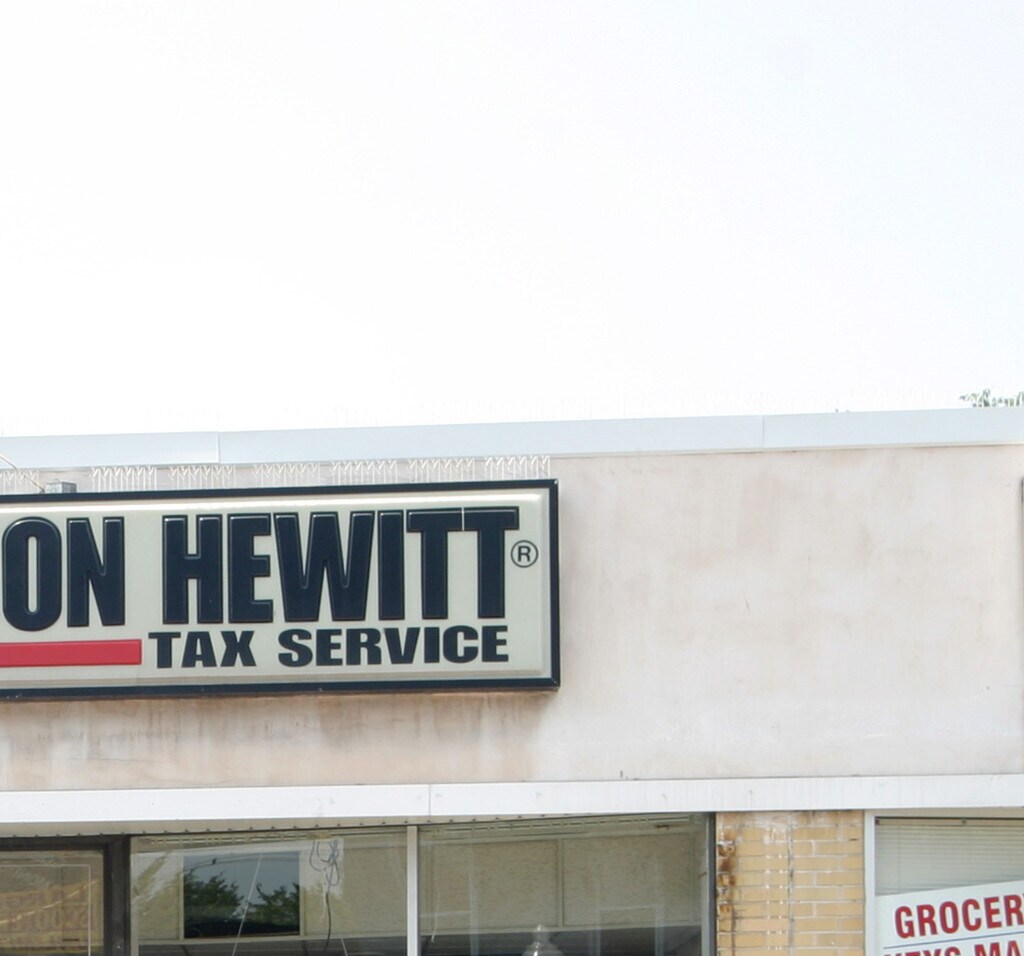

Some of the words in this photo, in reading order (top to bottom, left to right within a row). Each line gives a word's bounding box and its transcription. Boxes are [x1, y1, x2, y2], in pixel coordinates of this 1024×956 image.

[162, 506, 520, 625] HEWITT
[148, 630, 257, 669] TAX
[278, 625, 509, 667] SERVICE
